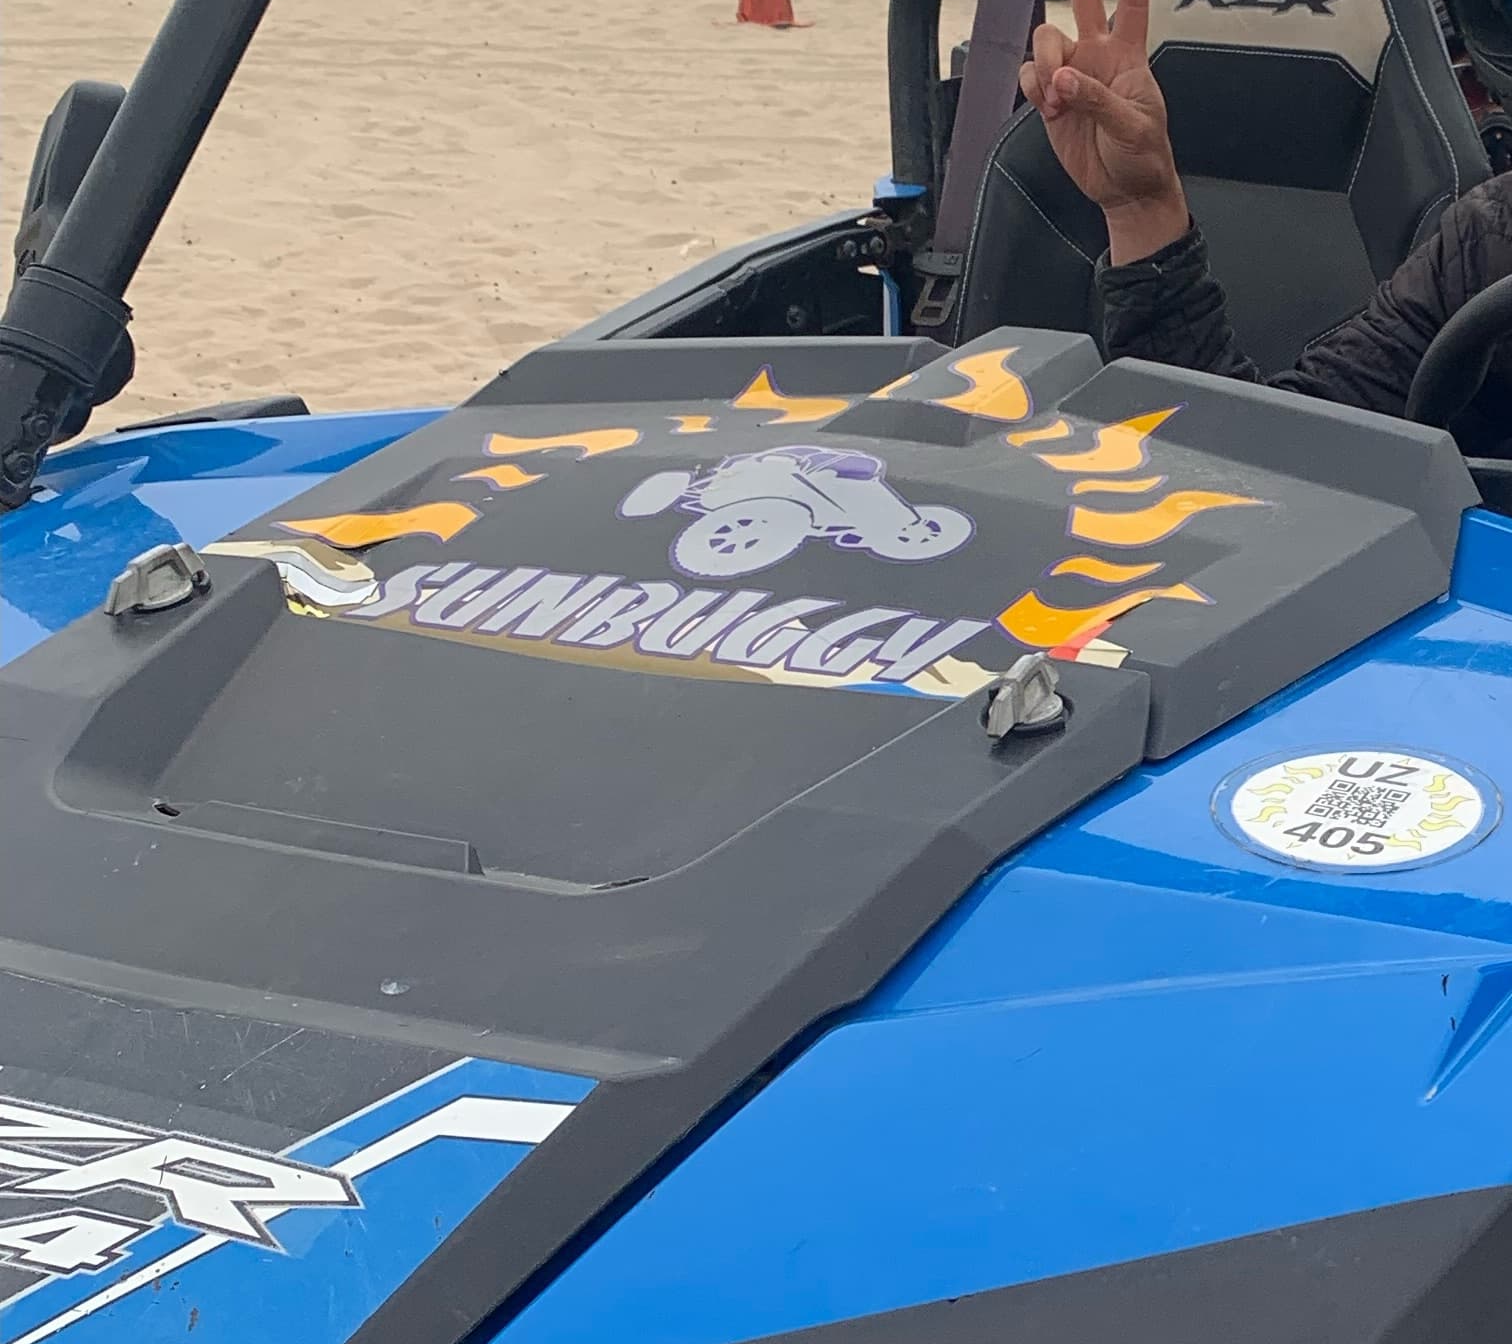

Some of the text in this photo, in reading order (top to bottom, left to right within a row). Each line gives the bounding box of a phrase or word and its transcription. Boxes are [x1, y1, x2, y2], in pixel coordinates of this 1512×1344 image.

[343, 558, 996, 684] SUNBUGGY
[1337, 756, 1420, 787] UZ
[1283, 821, 1392, 856] 405
